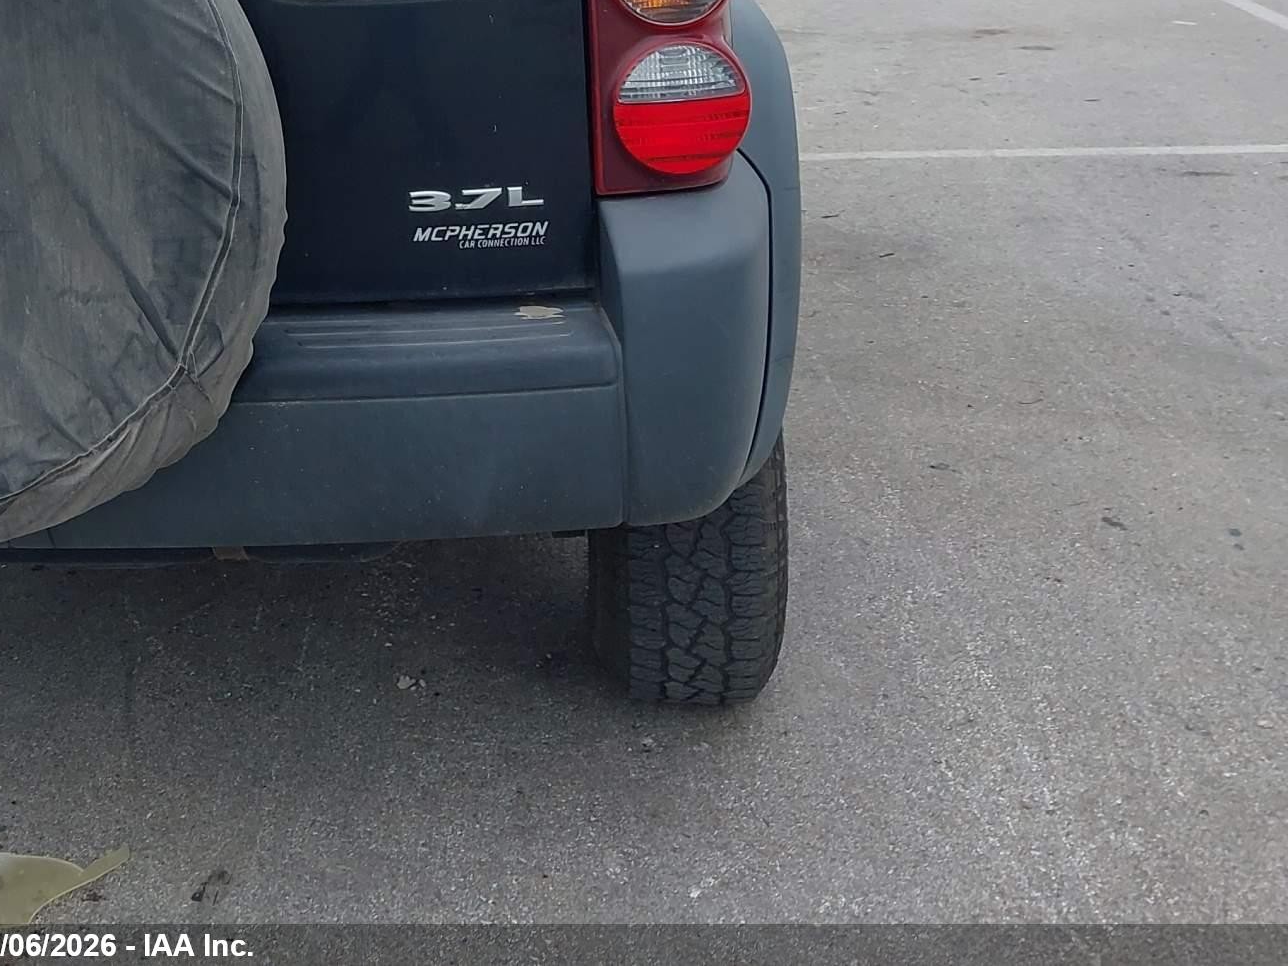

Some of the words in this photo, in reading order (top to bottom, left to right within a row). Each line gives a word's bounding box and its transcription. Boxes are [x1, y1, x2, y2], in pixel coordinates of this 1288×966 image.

[408, 186, 545, 212] 3.7L
[412, 220, 549, 242] MCPHERSON
[459, 240, 475, 249] CAR
[478, 237, 529, 249] CONNECTION
[531, 236, 546, 245] LLC
